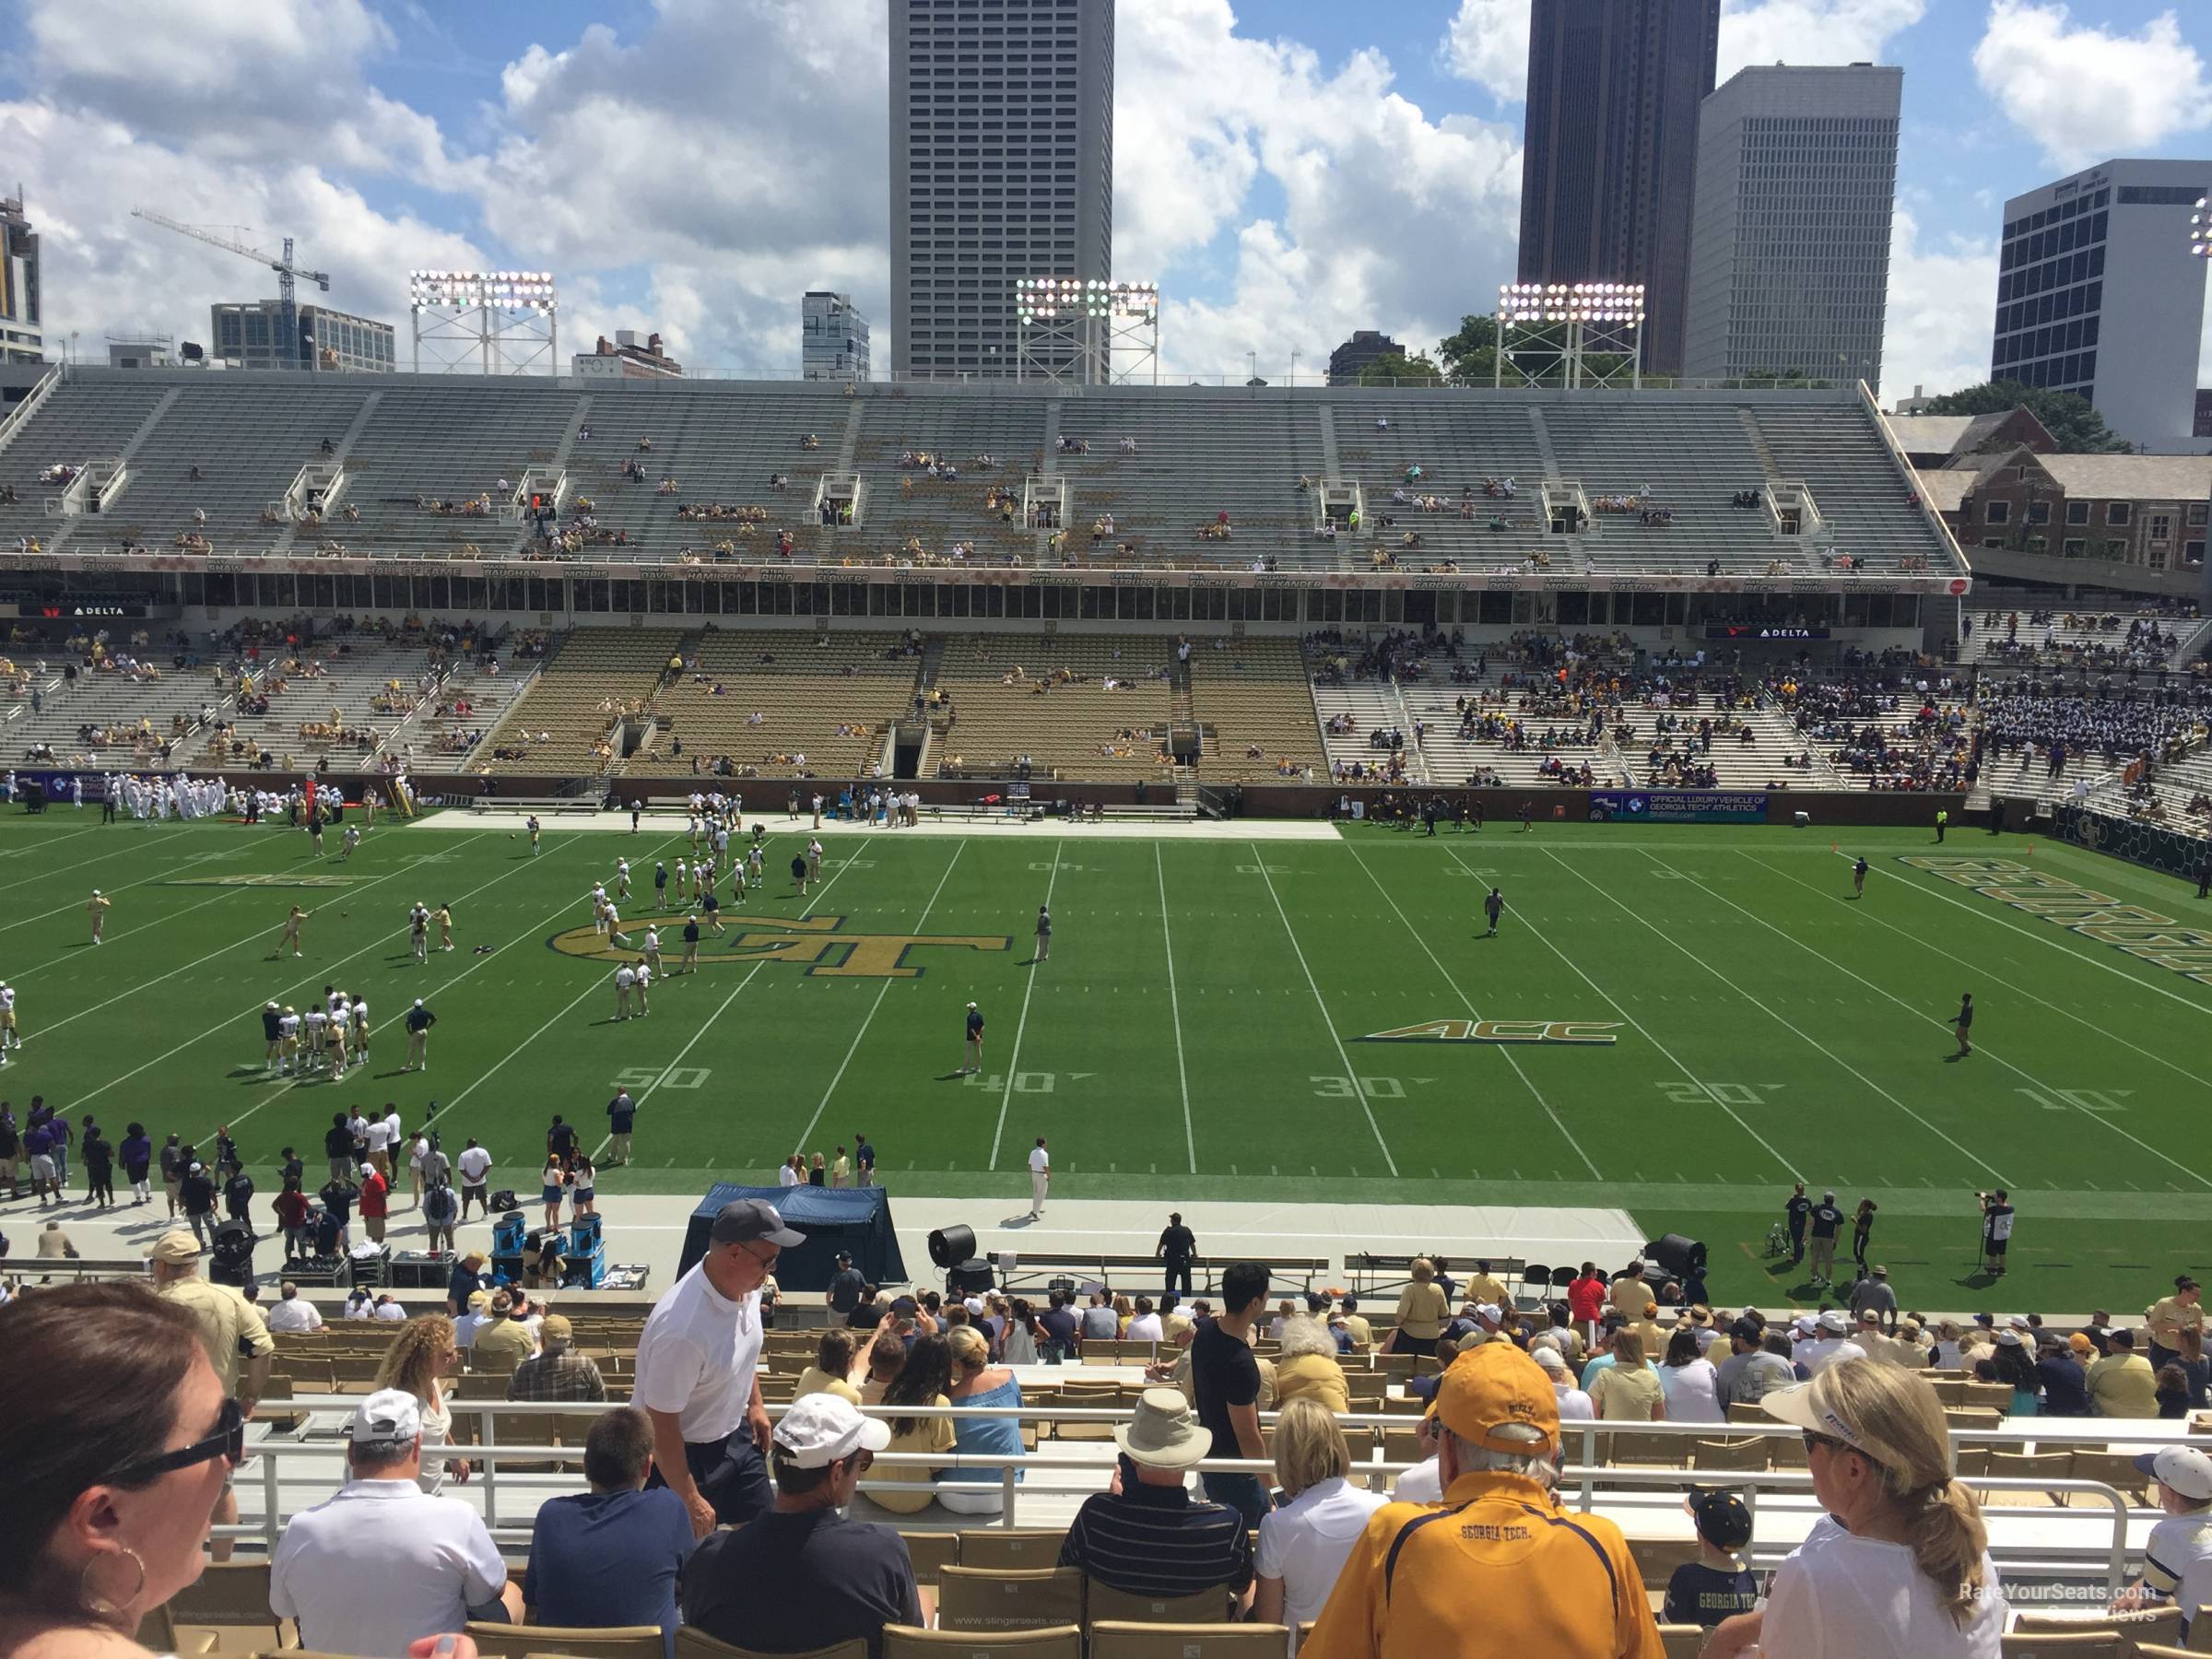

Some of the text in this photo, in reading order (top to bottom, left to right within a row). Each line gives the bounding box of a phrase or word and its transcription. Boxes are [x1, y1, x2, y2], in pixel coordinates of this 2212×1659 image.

[22, 560, 61, 571] FAME
[207, 564, 244, 572] SHAW
[366, 566, 461, 576] HALL OF FAME
[483, 570, 540, 578] BAUGHAN
[641, 572, 674, 581] DAVIS
[687, 572, 746, 581] HAMILTON
[817, 575, 870, 583] FLOWERS
[1112, 579, 1169, 587] STRUPPER
[1254, 580, 1322, 588] ALEXANDER
[1744, 584, 1778, 593] BECK
[1844, 584, 1900, 593] SWILLING
[86, 606, 124, 615] DELTA
[1650, 795, 1688, 804] OFFICIAL
[1720, 796, 1755, 805] VEHICLE
[1754, 796, 1766, 805] OF
[1650, 803, 1687, 811] GEORGIA
[546, 915, 1014, 978] GT
[1355, 1018, 1626, 1045] ACC
[609, 1067, 712, 1089] 50
[962, 1071, 1056, 1093] 40
[1309, 1077, 1407, 1098] 30
[1654, 1082, 1766, 1104] 20
[2014, 1088, 2131, 1111] 10
[1461, 1525, 1501, 1541] GEORGIA
[1699, 1592, 1740, 1609] GEORGIA
[953, 1617, 1072, 1626] www.stingerseats.com
